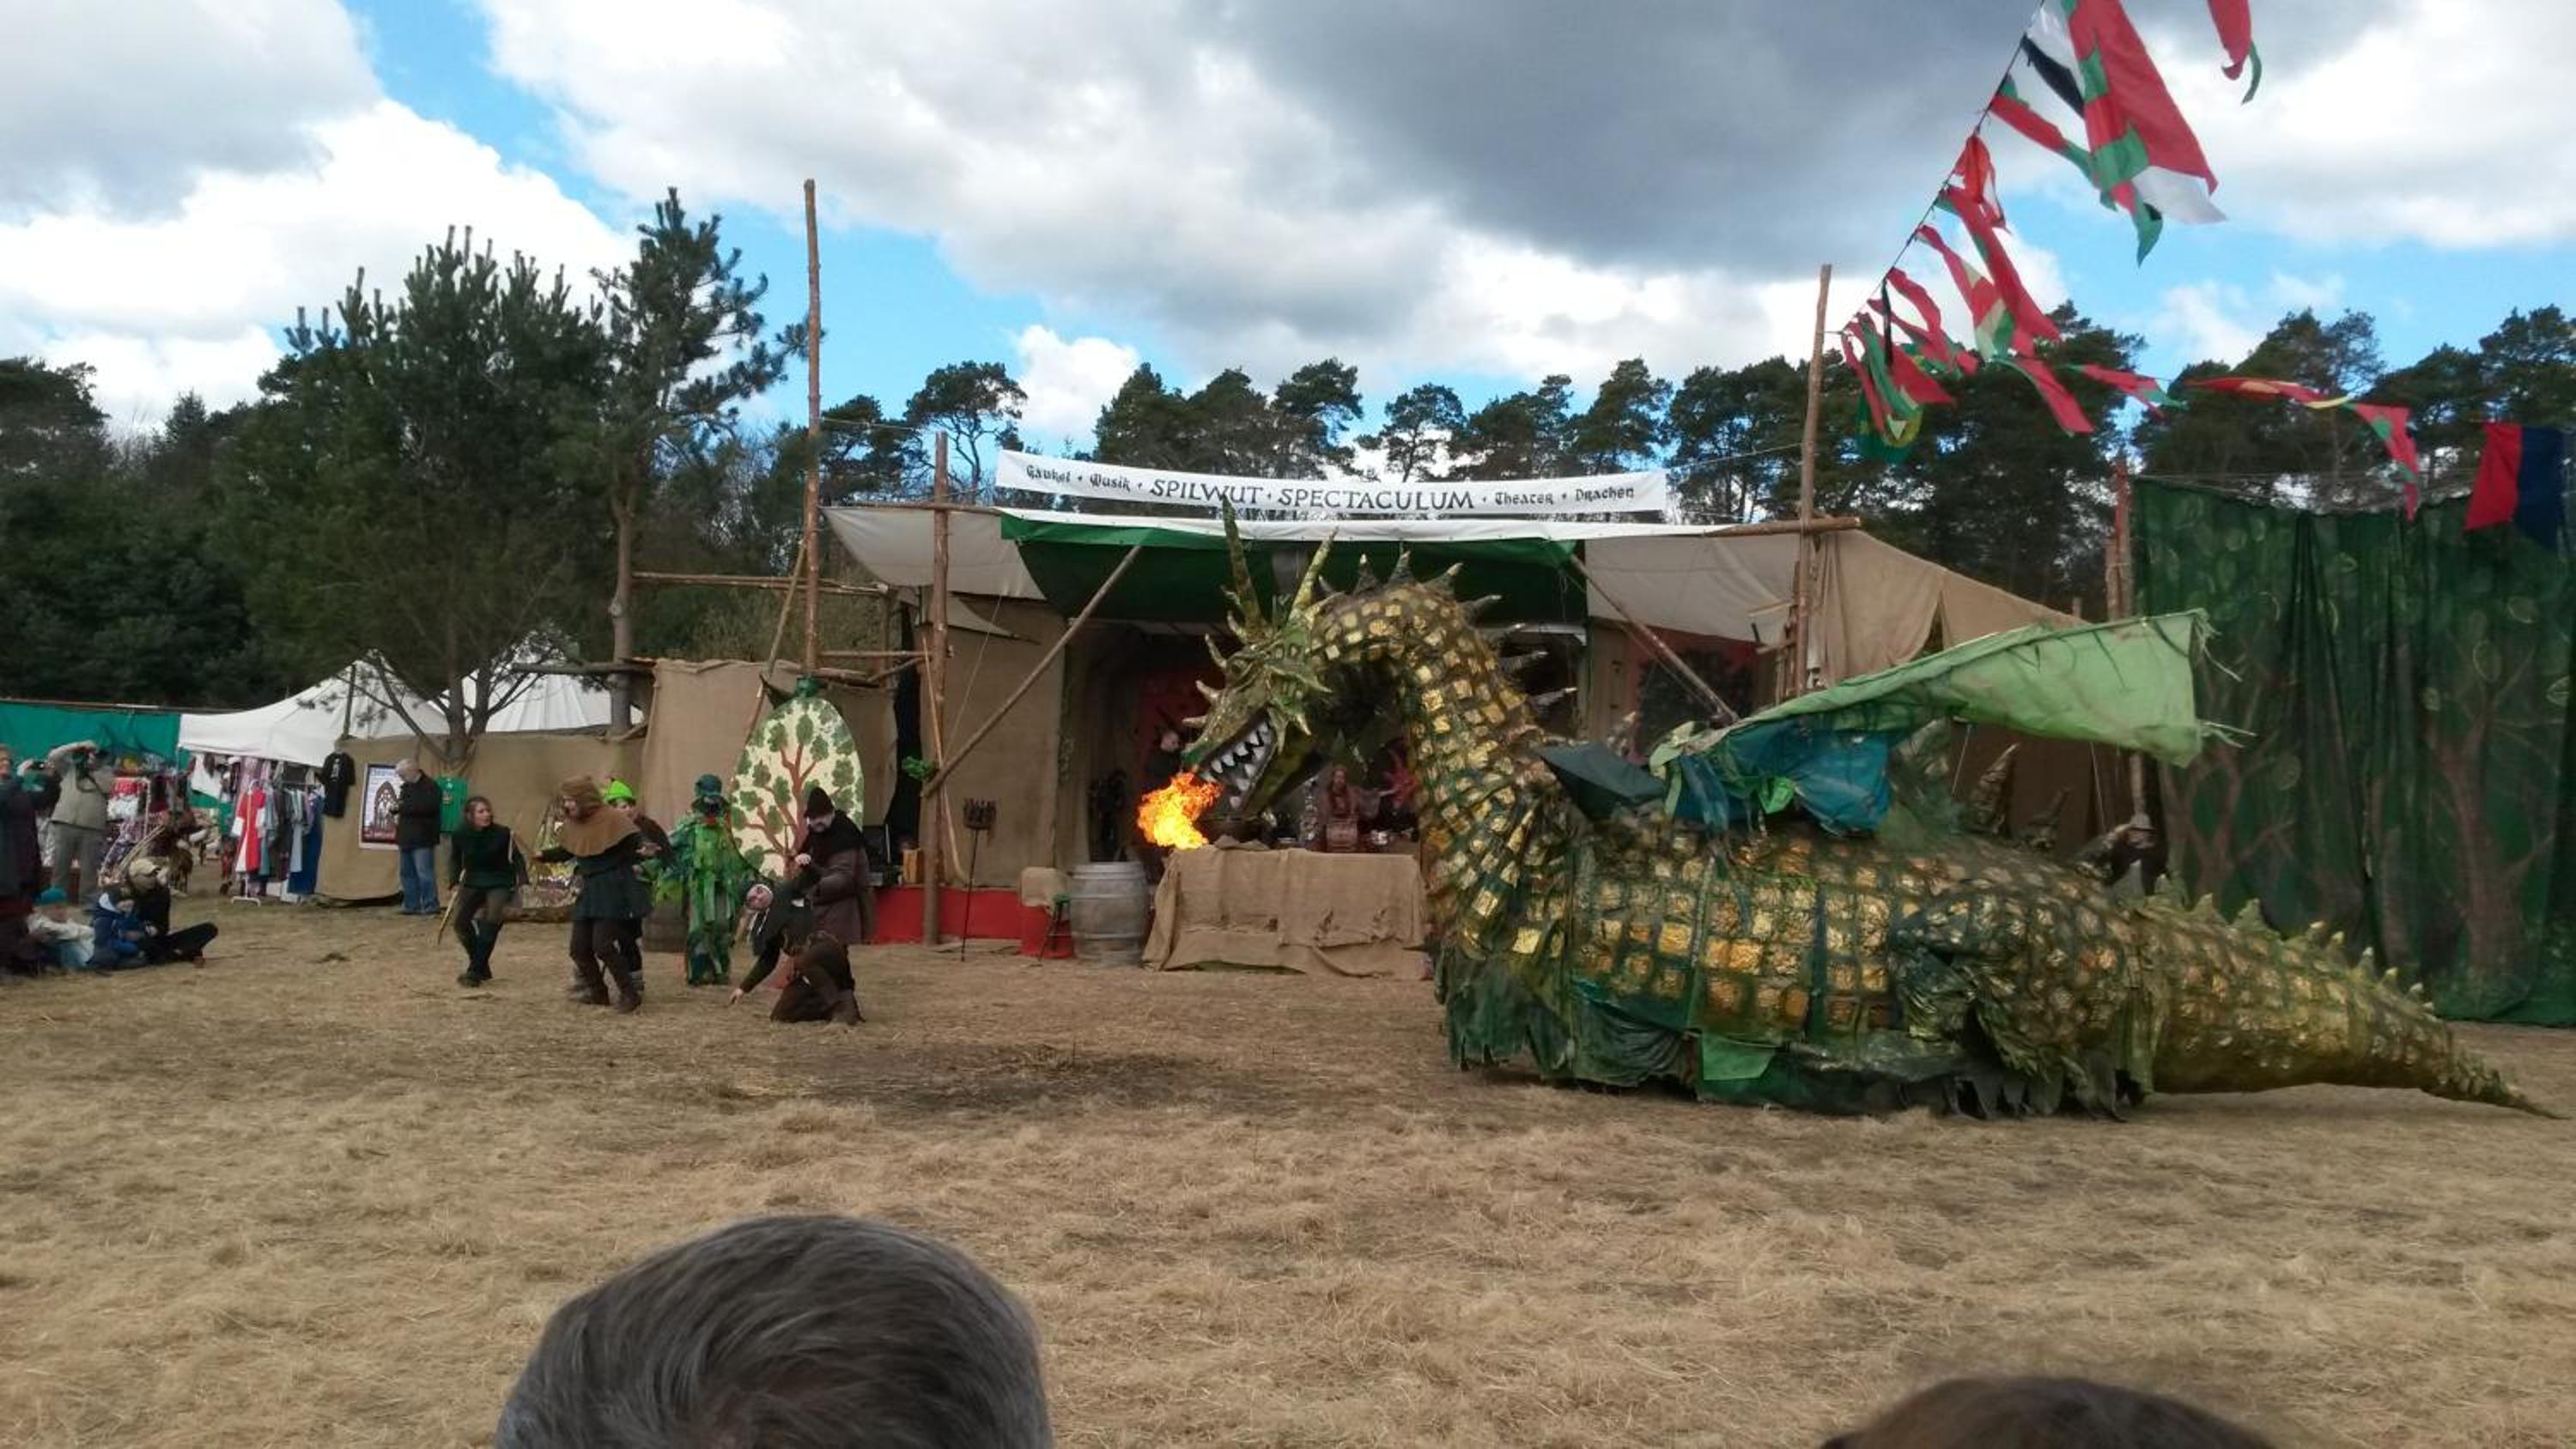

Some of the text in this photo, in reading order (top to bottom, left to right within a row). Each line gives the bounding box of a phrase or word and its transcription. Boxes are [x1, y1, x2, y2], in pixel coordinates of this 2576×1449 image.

[1149, 479, 1263, 505] SPILWUT
[1278, 488, 1474, 510] SPECTACULUM
[1495, 492, 1553, 505] Theater
[1575, 487, 1634, 502] Drachen
